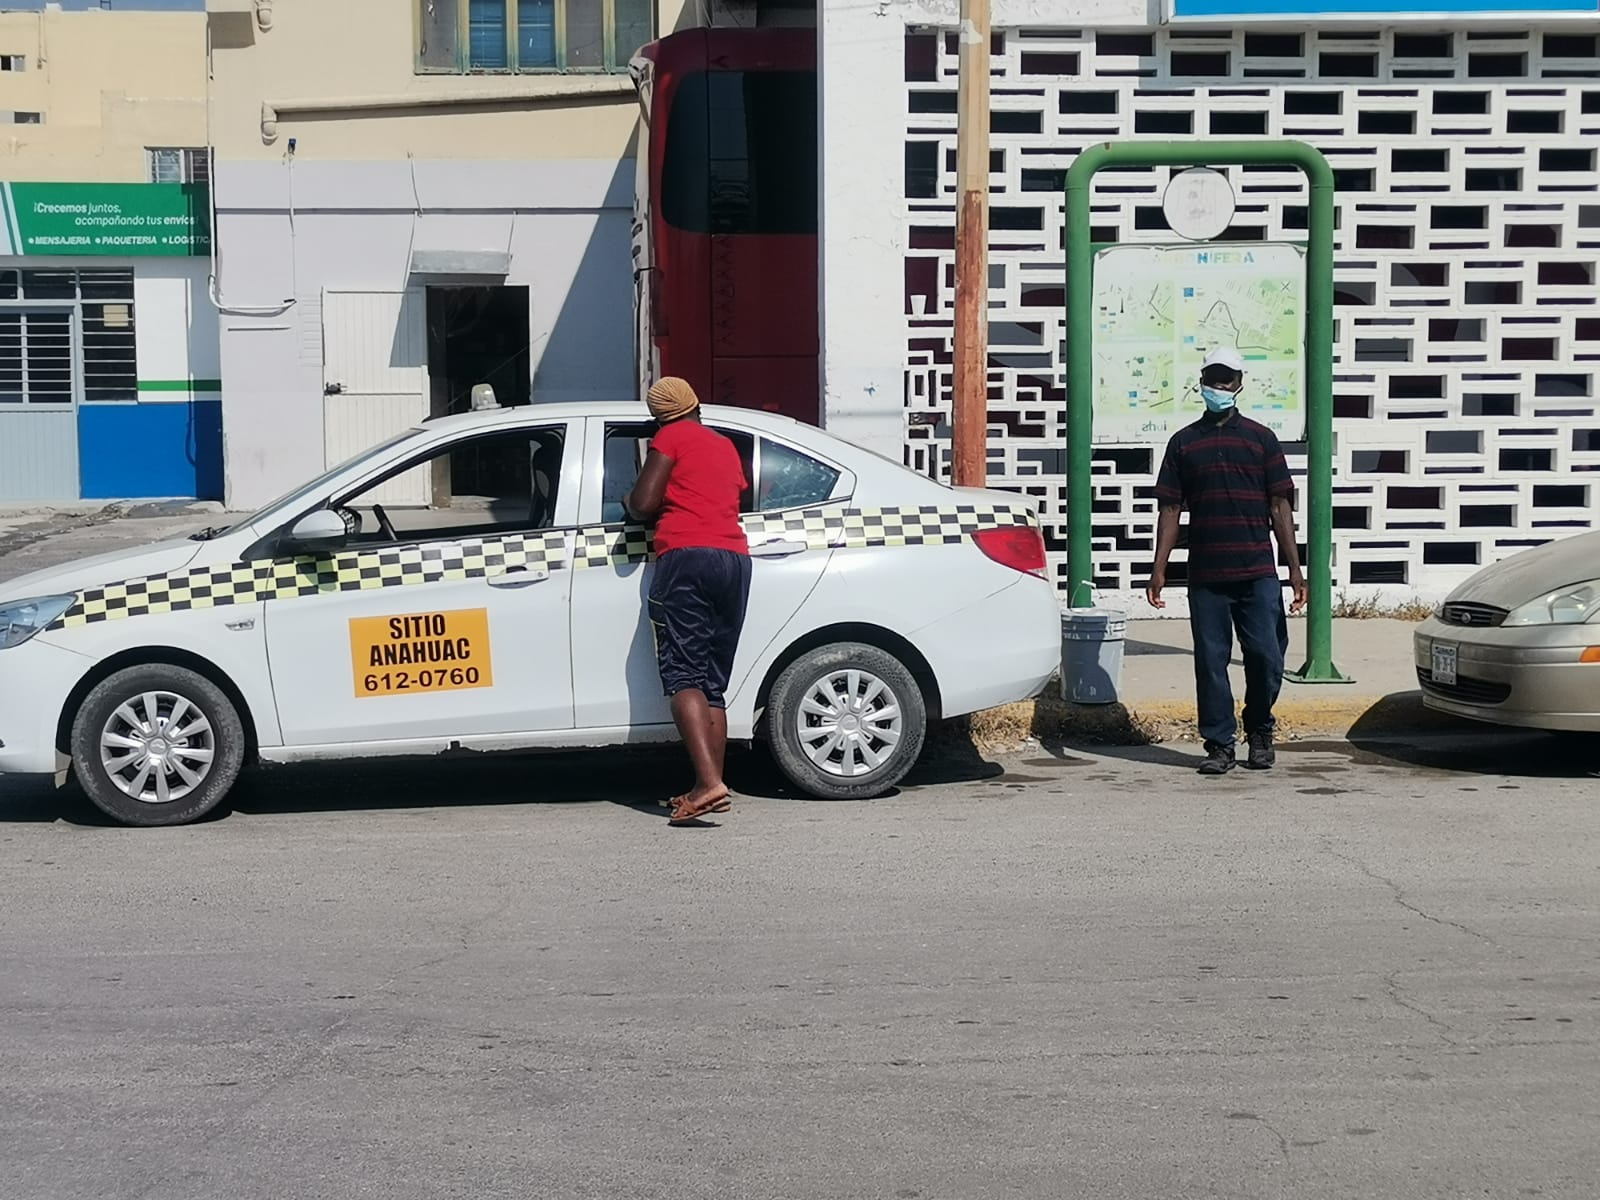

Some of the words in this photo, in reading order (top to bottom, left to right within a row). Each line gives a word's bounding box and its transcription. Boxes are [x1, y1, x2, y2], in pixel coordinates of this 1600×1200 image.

[33, 202, 87, 213] ¡Crecemos
[88, 202, 121, 215] juntos,
[75, 215, 145, 227] acompañando
[146, 216, 162, 225] tus
[35, 236, 91, 245] MENSAJERIA
[102, 236, 157, 245] PAQUETERIA
[389, 613, 446, 640] SITIO
[370, 637, 471, 667] ANAHUAC
[364, 666, 479, 692] 612-0760
